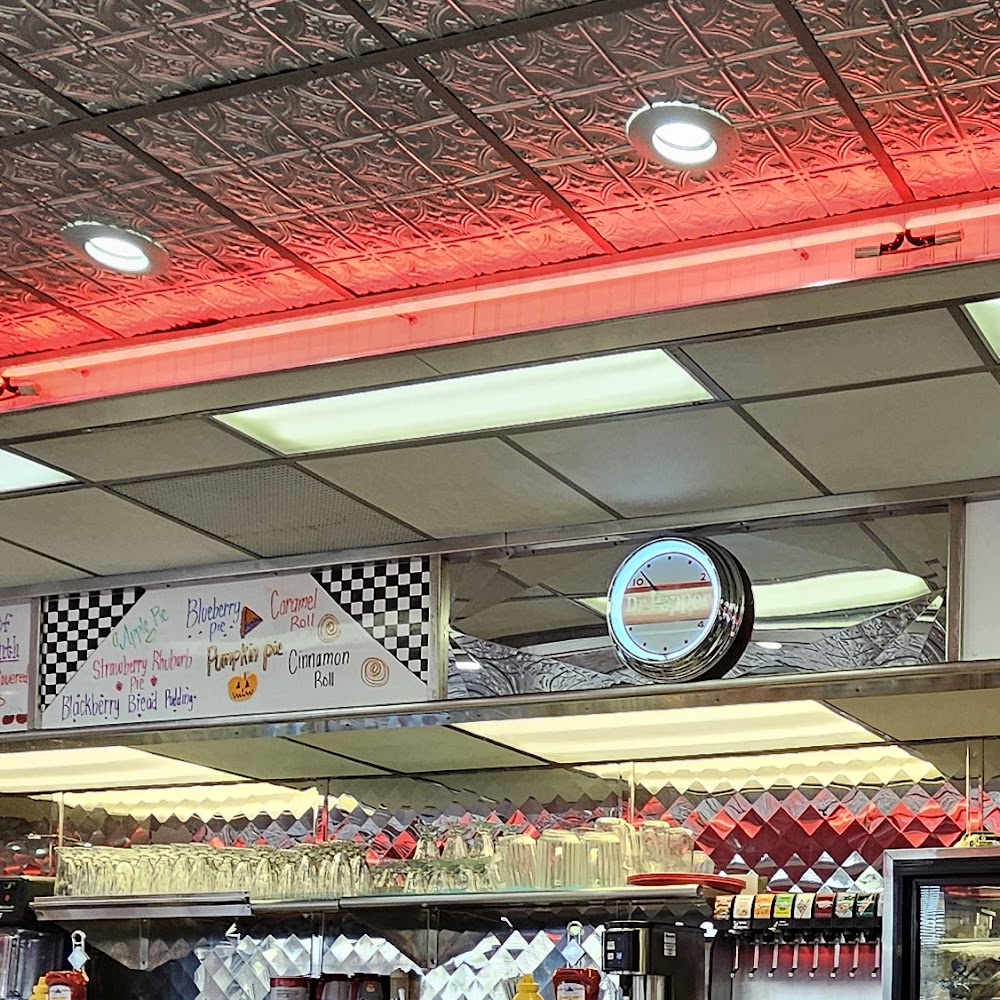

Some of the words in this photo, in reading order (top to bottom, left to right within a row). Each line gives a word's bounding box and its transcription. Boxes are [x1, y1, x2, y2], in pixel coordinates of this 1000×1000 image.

[632, 578, 644, 587] 10
[700, 572, 707, 581] 2
[186, 597, 242, 629] Blueberry
[270, 587, 319, 620] Caramel
[290, 614, 315, 632] Roll
[92, 656, 148, 679] Strawberry
[151, 650, 193, 672] Rhubarb
[207, 642, 259, 676] Pumpkin
[288, 649, 351, 675] Cinnamon
[314, 671, 335, 688] Roll
[61, 694, 120, 720] Blackberry
[128, 693, 158, 713] Bread
[164, 687, 194, 712] Pudding
